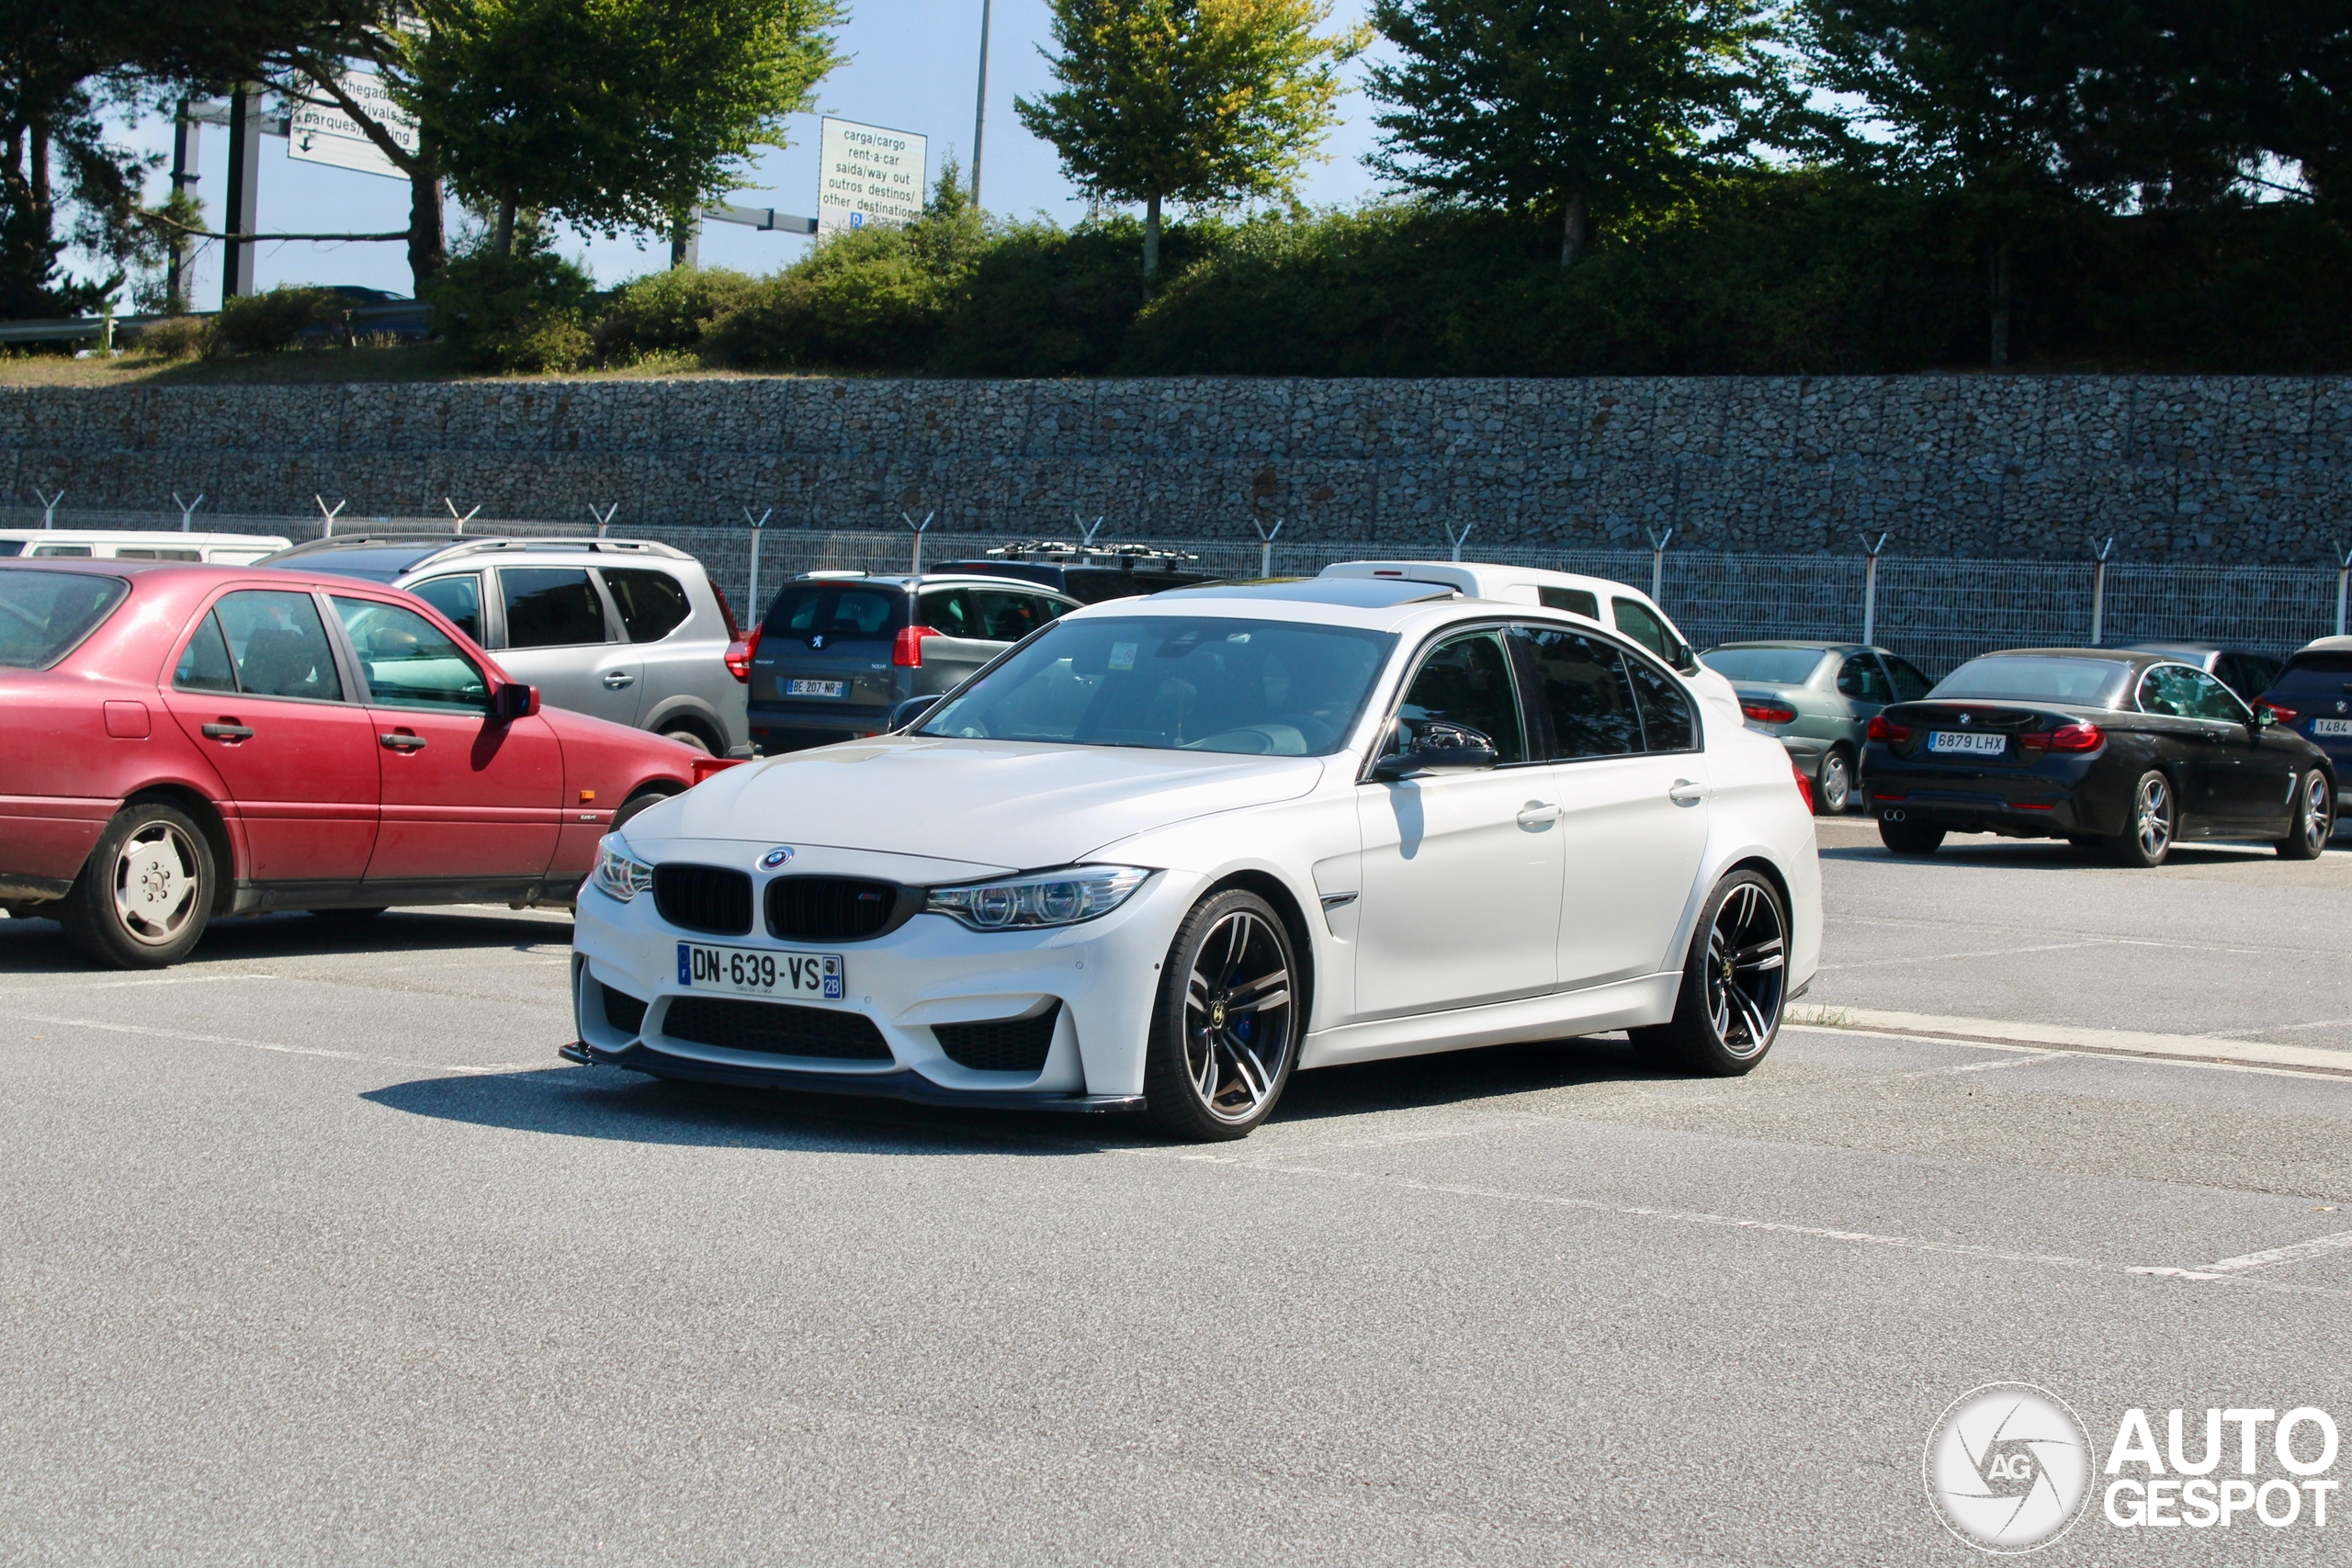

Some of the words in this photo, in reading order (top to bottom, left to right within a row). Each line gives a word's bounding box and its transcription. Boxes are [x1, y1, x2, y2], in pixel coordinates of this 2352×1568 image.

[844, 130, 905, 151] carga/cargo
[848, 148, 899, 166] rent-a-car
[893, 172, 910, 185] out
[829, 177, 863, 193] outros
[868, 184, 915, 203] destinos/
[822, 192, 851, 208] other
[793, 681, 836, 694] BE-207-NR
[2320, 721, 2347, 732] 1484
[1939, 734, 1973, 748] 6879
[1975, 736, 2003, 750] LHX
[693, 948, 820, 990] DN-639-VS
[824, 978, 840, 996] 2B
